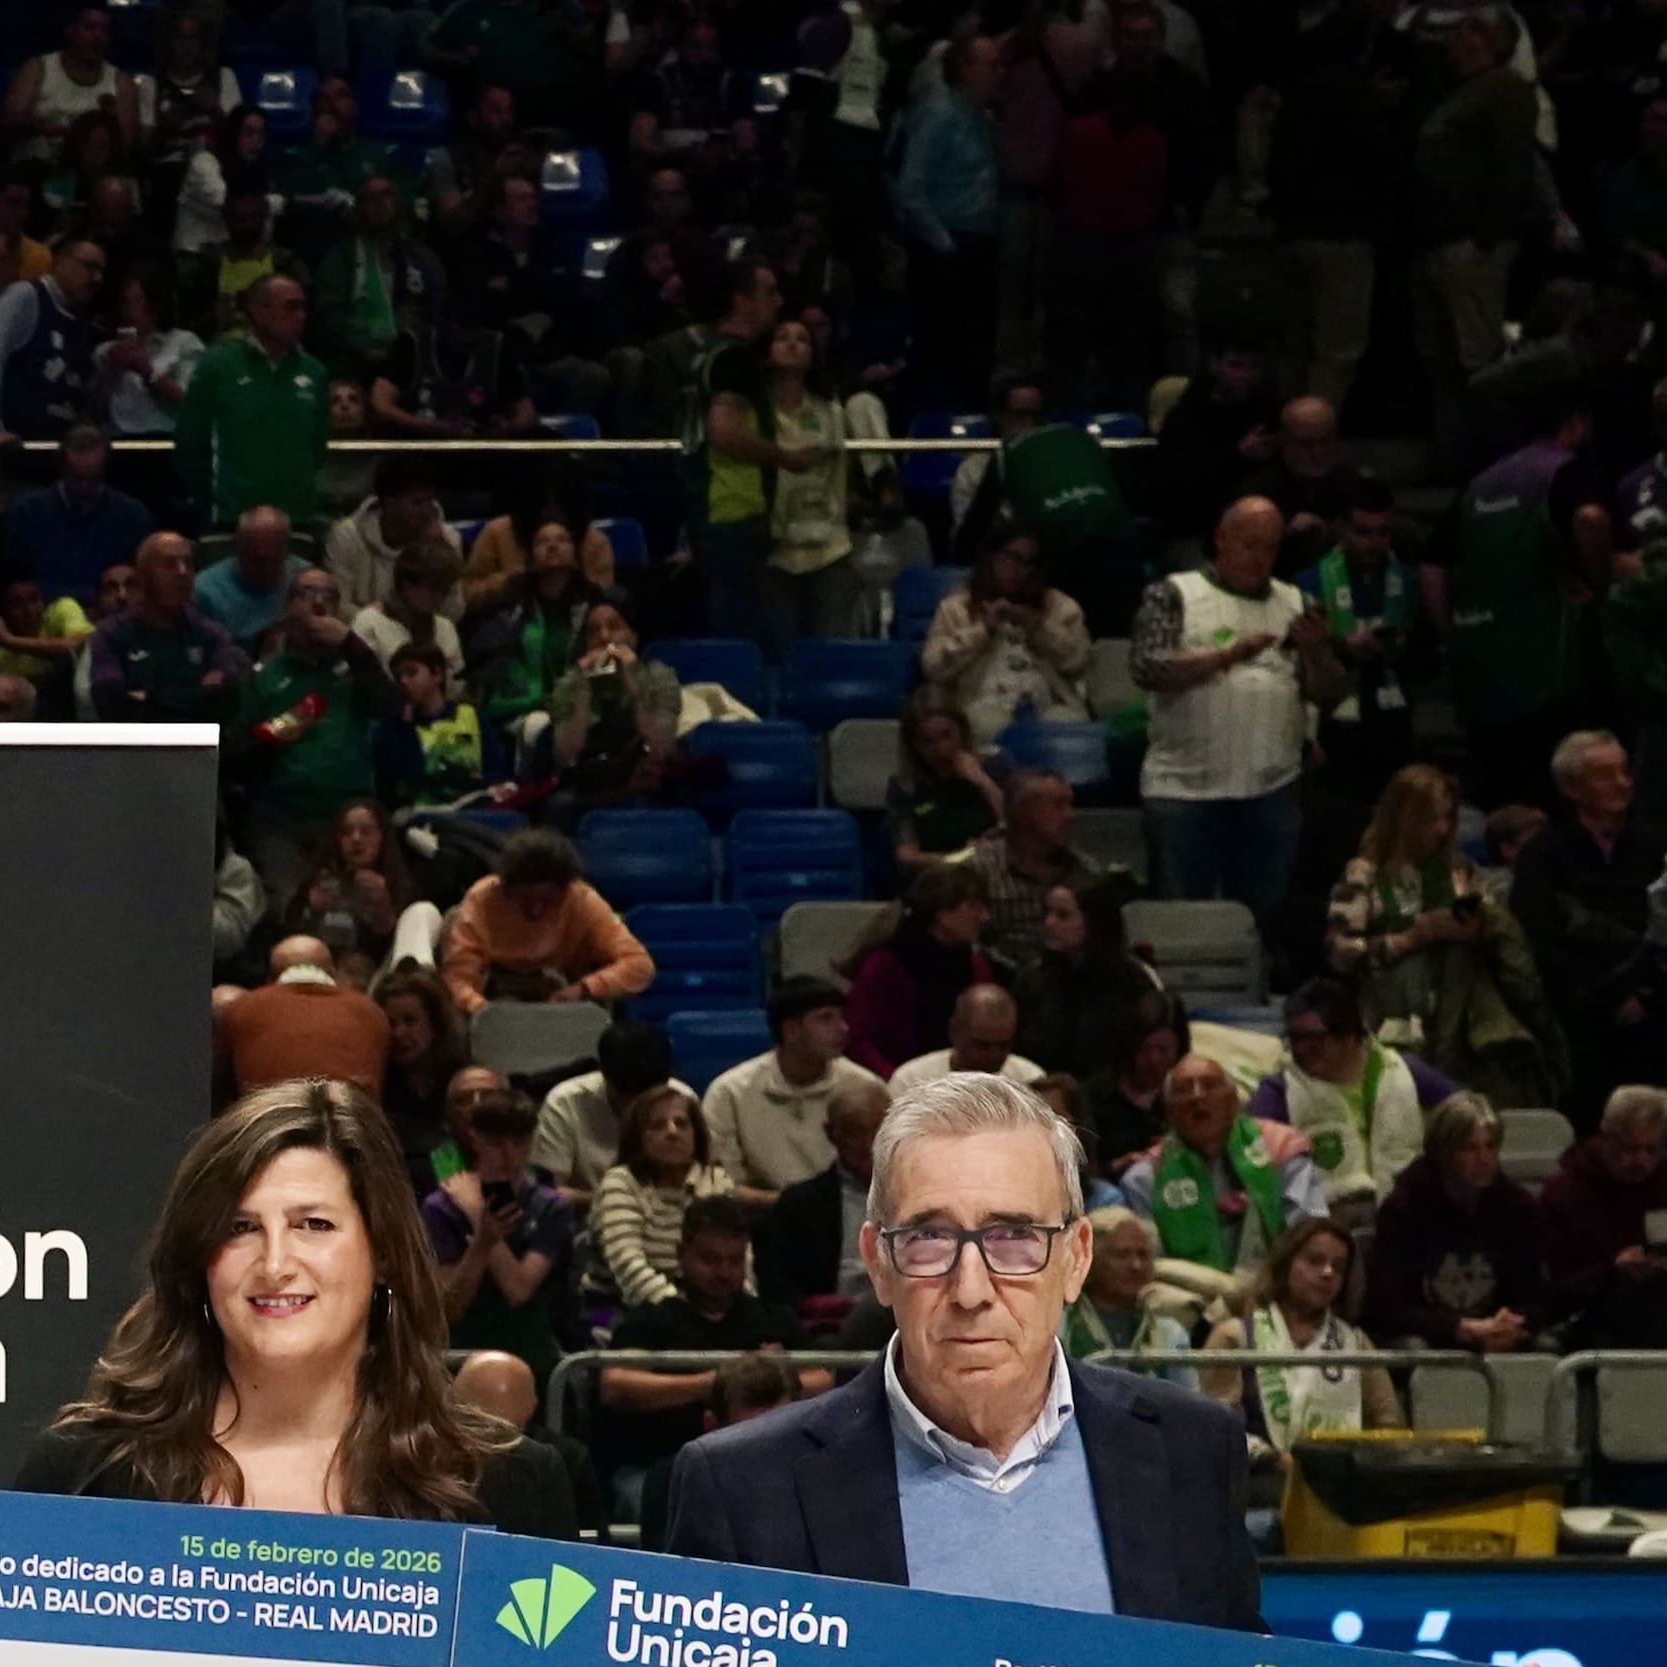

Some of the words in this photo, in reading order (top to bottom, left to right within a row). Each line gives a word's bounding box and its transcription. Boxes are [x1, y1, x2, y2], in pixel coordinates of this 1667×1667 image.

[180, 1535, 204, 1556] 15
[210, 1538, 241, 1559] de
[247, 1540, 338, 1566] febrero
[344, 1547, 374, 1568] de
[380, 1549, 441, 1573] 2026
[22, 1554, 143, 1584] dedicado
[149, 1567, 165, 1585] a
[172, 1564, 193, 1587] la
[200, 1566, 335, 1597] Fundación
[342, 1576, 438, 1610] Unicaja
[44, 1587, 230, 1623] BALONCESTO
[254, 1603, 323, 1630] REAL
[330, 1608, 437, 1637] MADRID
[610, 1579, 847, 1647] Fundación
